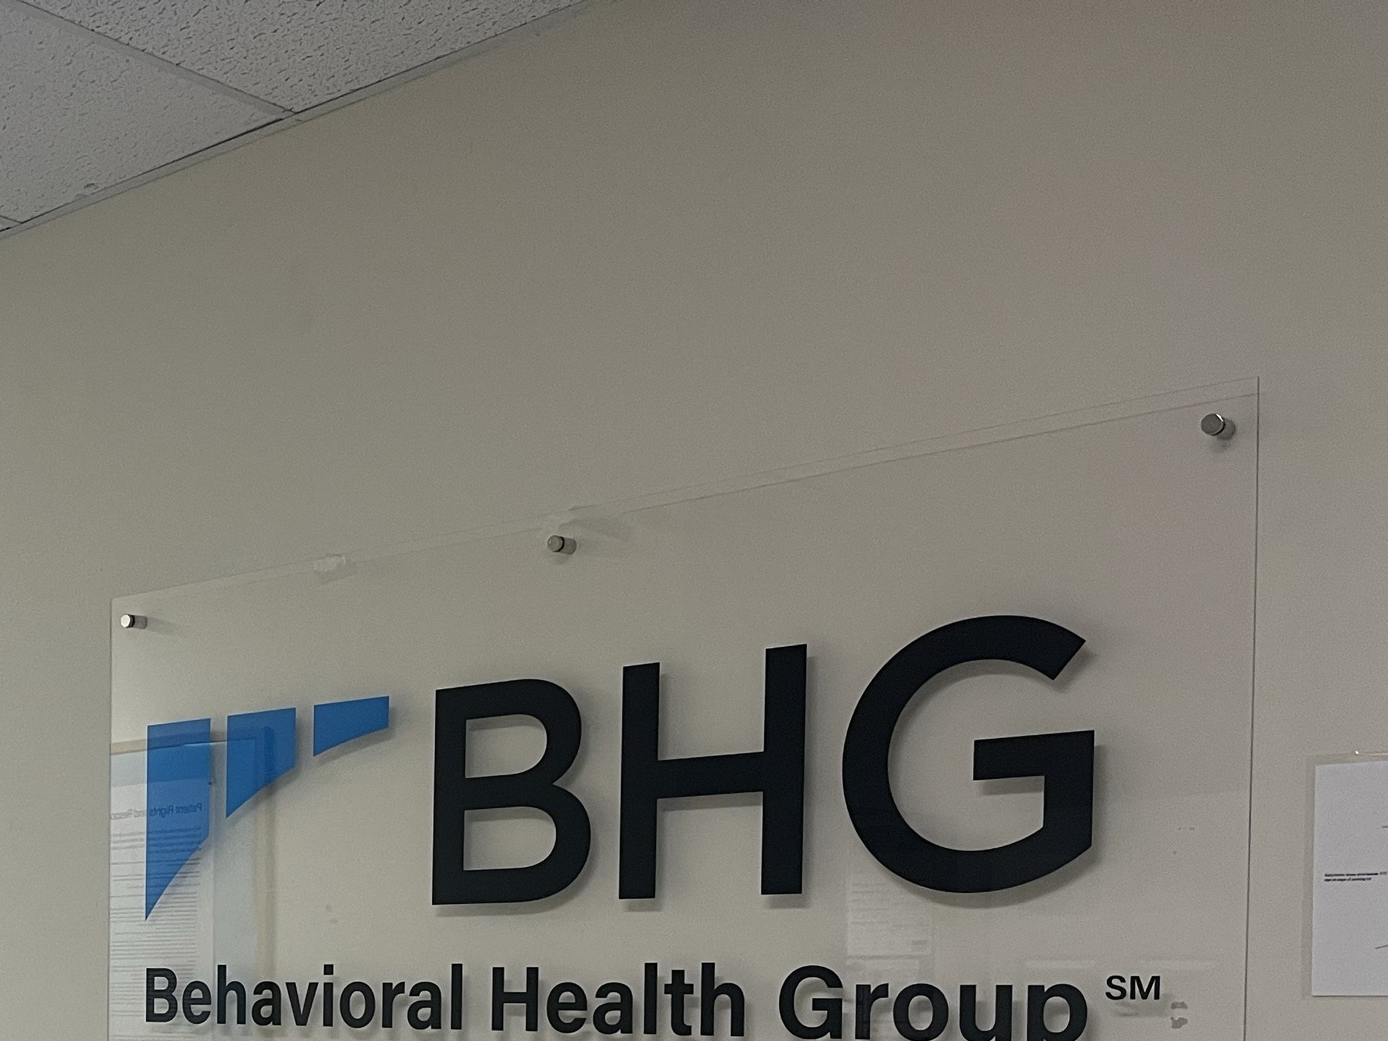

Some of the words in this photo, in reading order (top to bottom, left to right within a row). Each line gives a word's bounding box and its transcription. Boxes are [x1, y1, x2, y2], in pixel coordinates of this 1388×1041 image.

[432, 615, 1095, 906] BHG
[146, 964, 463, 1031] Behavioral
[492, 963, 745, 1037] Health
[1105, 975, 1161, 1001] SM
